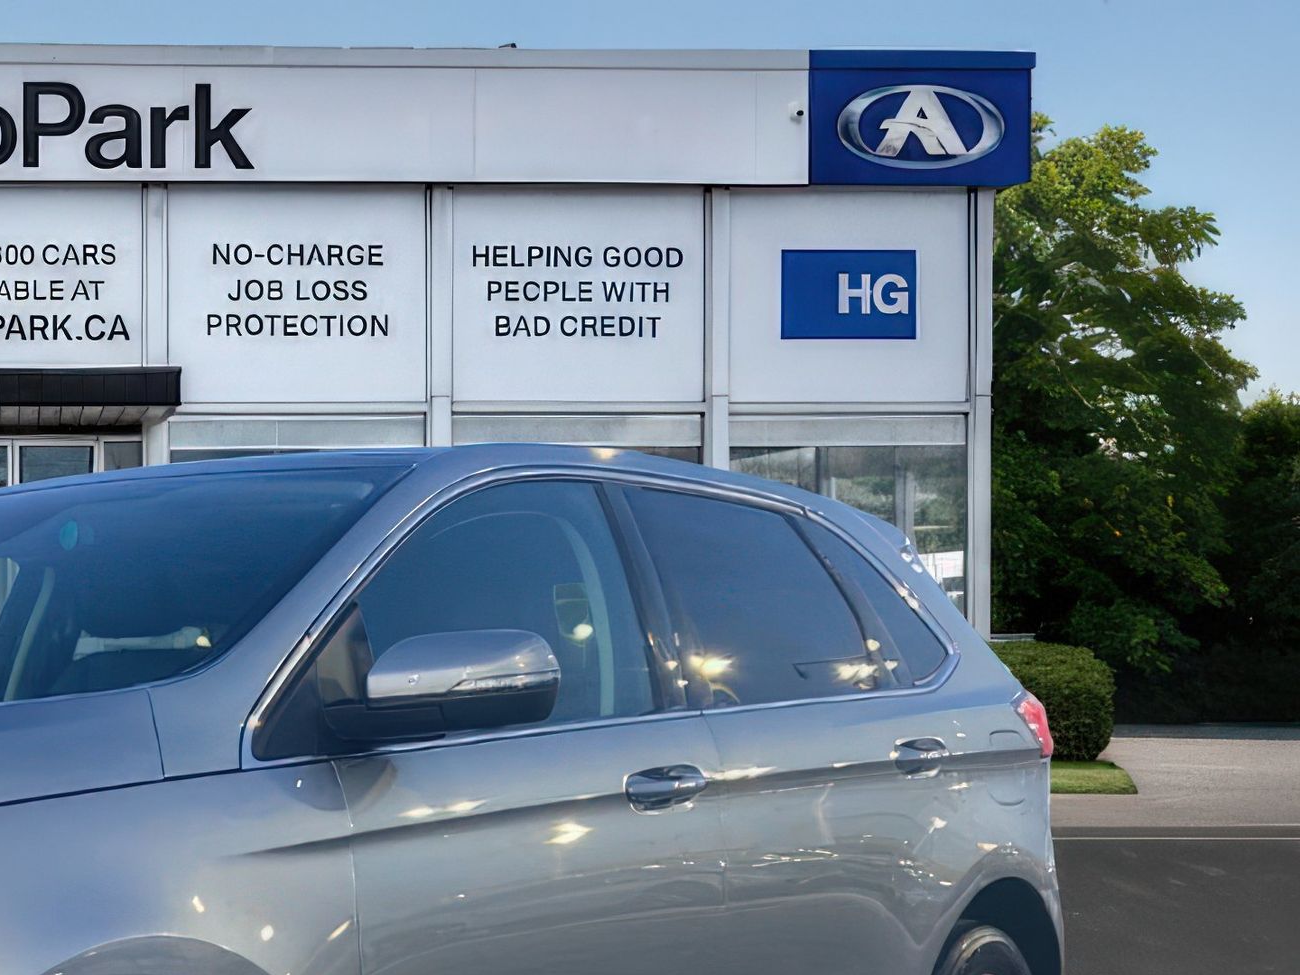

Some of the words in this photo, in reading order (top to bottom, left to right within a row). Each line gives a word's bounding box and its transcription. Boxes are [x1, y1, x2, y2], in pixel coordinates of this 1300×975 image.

[41, 243, 116, 266] CARS
[212, 243, 384, 267] NO-CHARGE
[472, 244, 593, 268] HELPING
[602, 245, 684, 269] GOOD
[70, 279, 105, 302] AT
[227, 279, 284, 302] JOB
[296, 279, 368, 302] LOSS
[487, 280, 593, 303] PEOPLE
[601, 280, 670, 303] WITH
[838, 273, 909, 315] HG
[206, 313, 389, 337] PROTECTION
[495, 314, 551, 338] BAD
[560, 315, 662, 339] CREDIT
